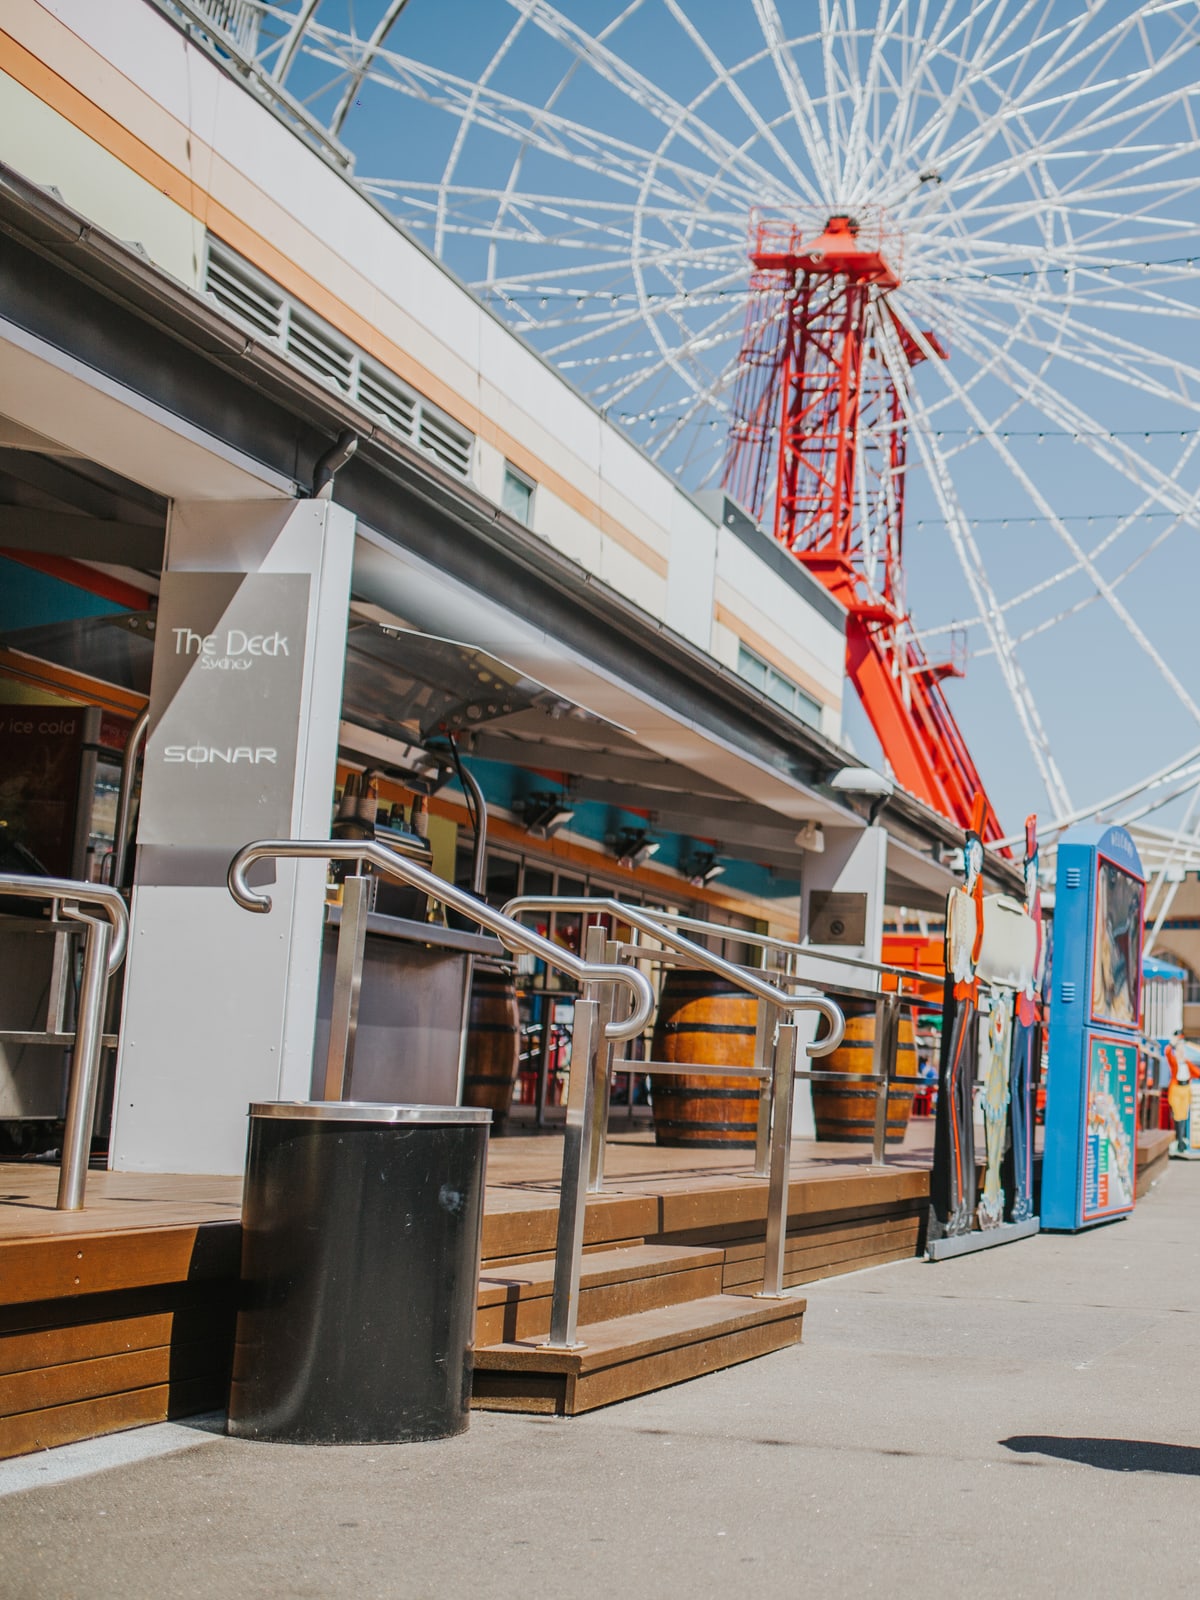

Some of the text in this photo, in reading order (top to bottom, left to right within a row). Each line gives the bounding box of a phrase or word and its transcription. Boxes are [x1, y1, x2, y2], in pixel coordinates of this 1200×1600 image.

[171, 628, 290, 656] The Deck
[201, 655, 252, 670] Sydney
[8, 718, 33, 734] ice
[38, 720, 76, 735] cold
[163, 743, 277, 766] SONAR
